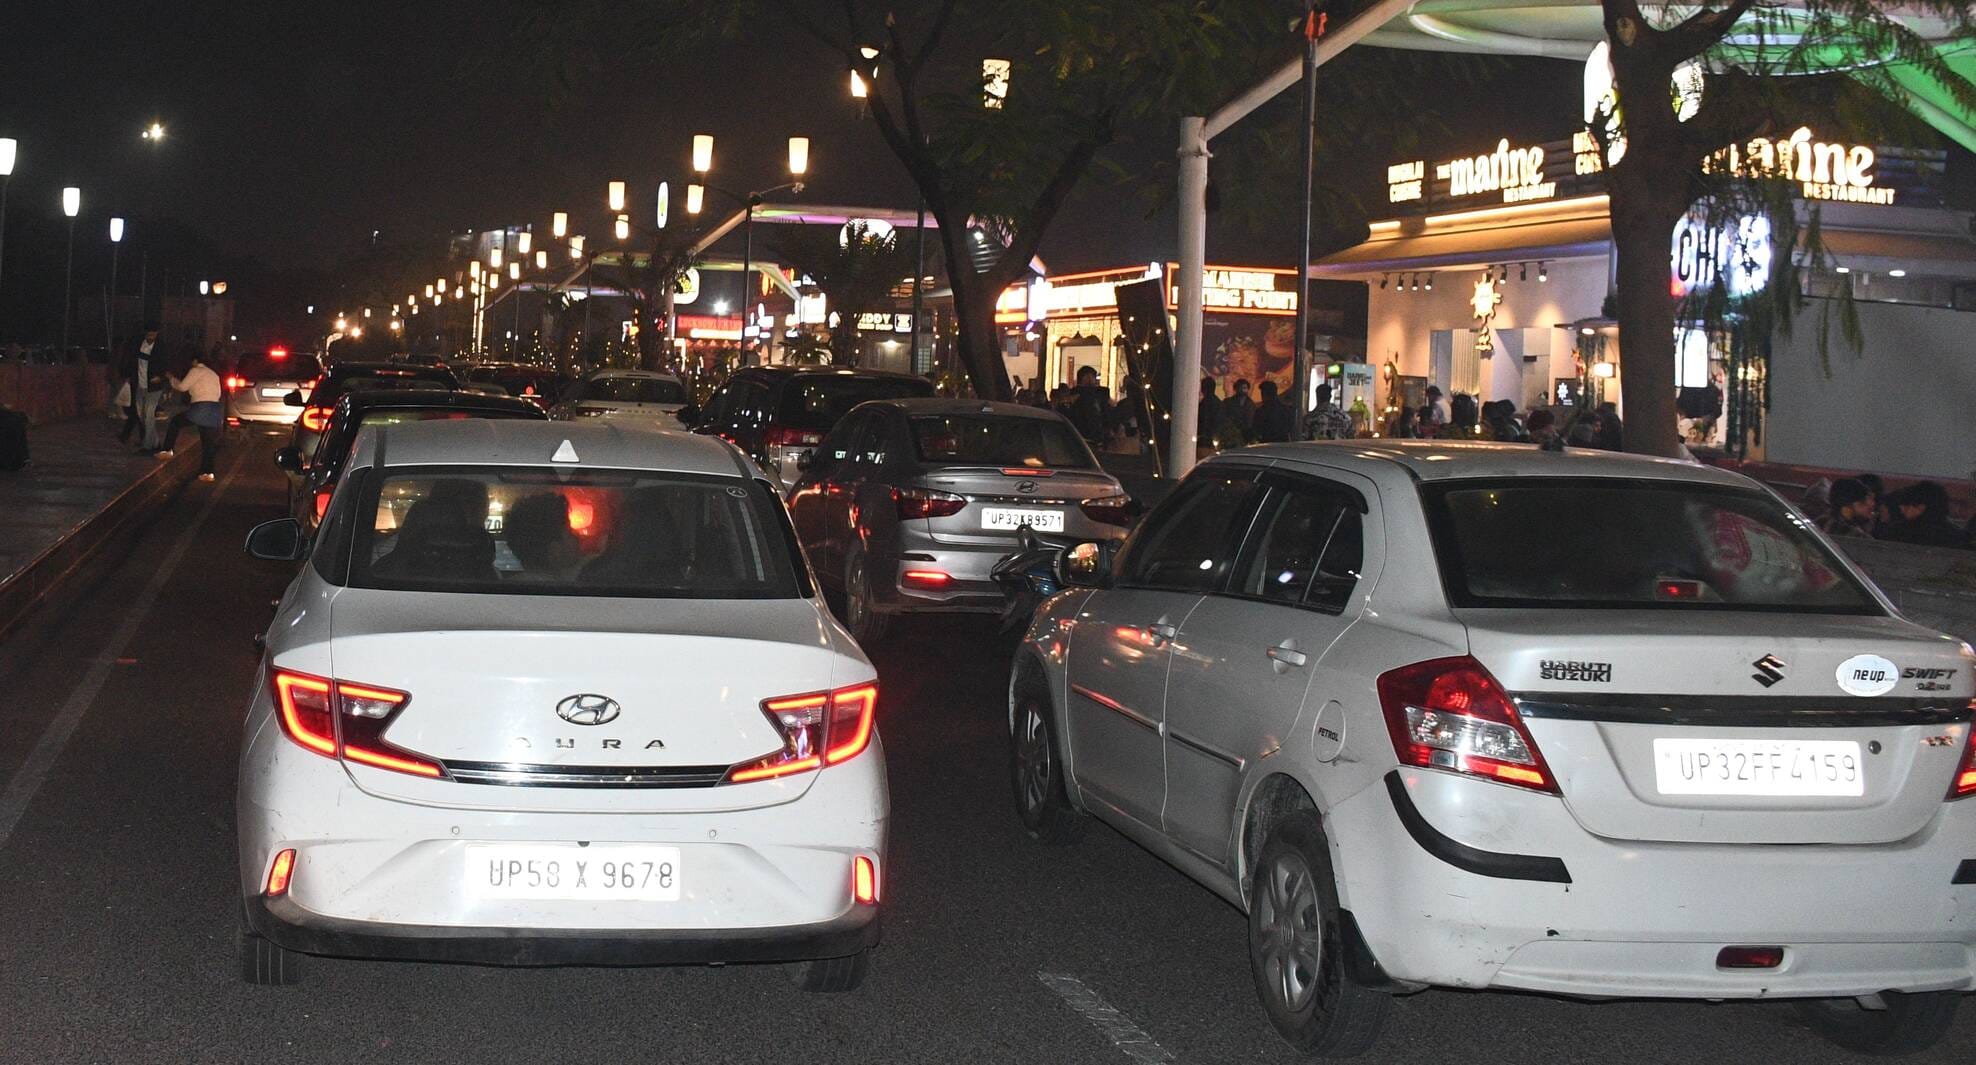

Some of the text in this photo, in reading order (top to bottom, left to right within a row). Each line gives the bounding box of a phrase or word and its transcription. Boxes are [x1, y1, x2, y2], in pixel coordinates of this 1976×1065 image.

[1803, 182, 1896, 205] RESTAURANT
[1540, 670, 1611, 683] SUZUKI
[1902, 666, 1958, 680] SWIFT
[1318, 727, 1339, 742] PETROL
[1679, 752, 1857, 782] UP32FF4159
[576, 860, 588, 889] X
[602, 861, 673, 889] 9678
